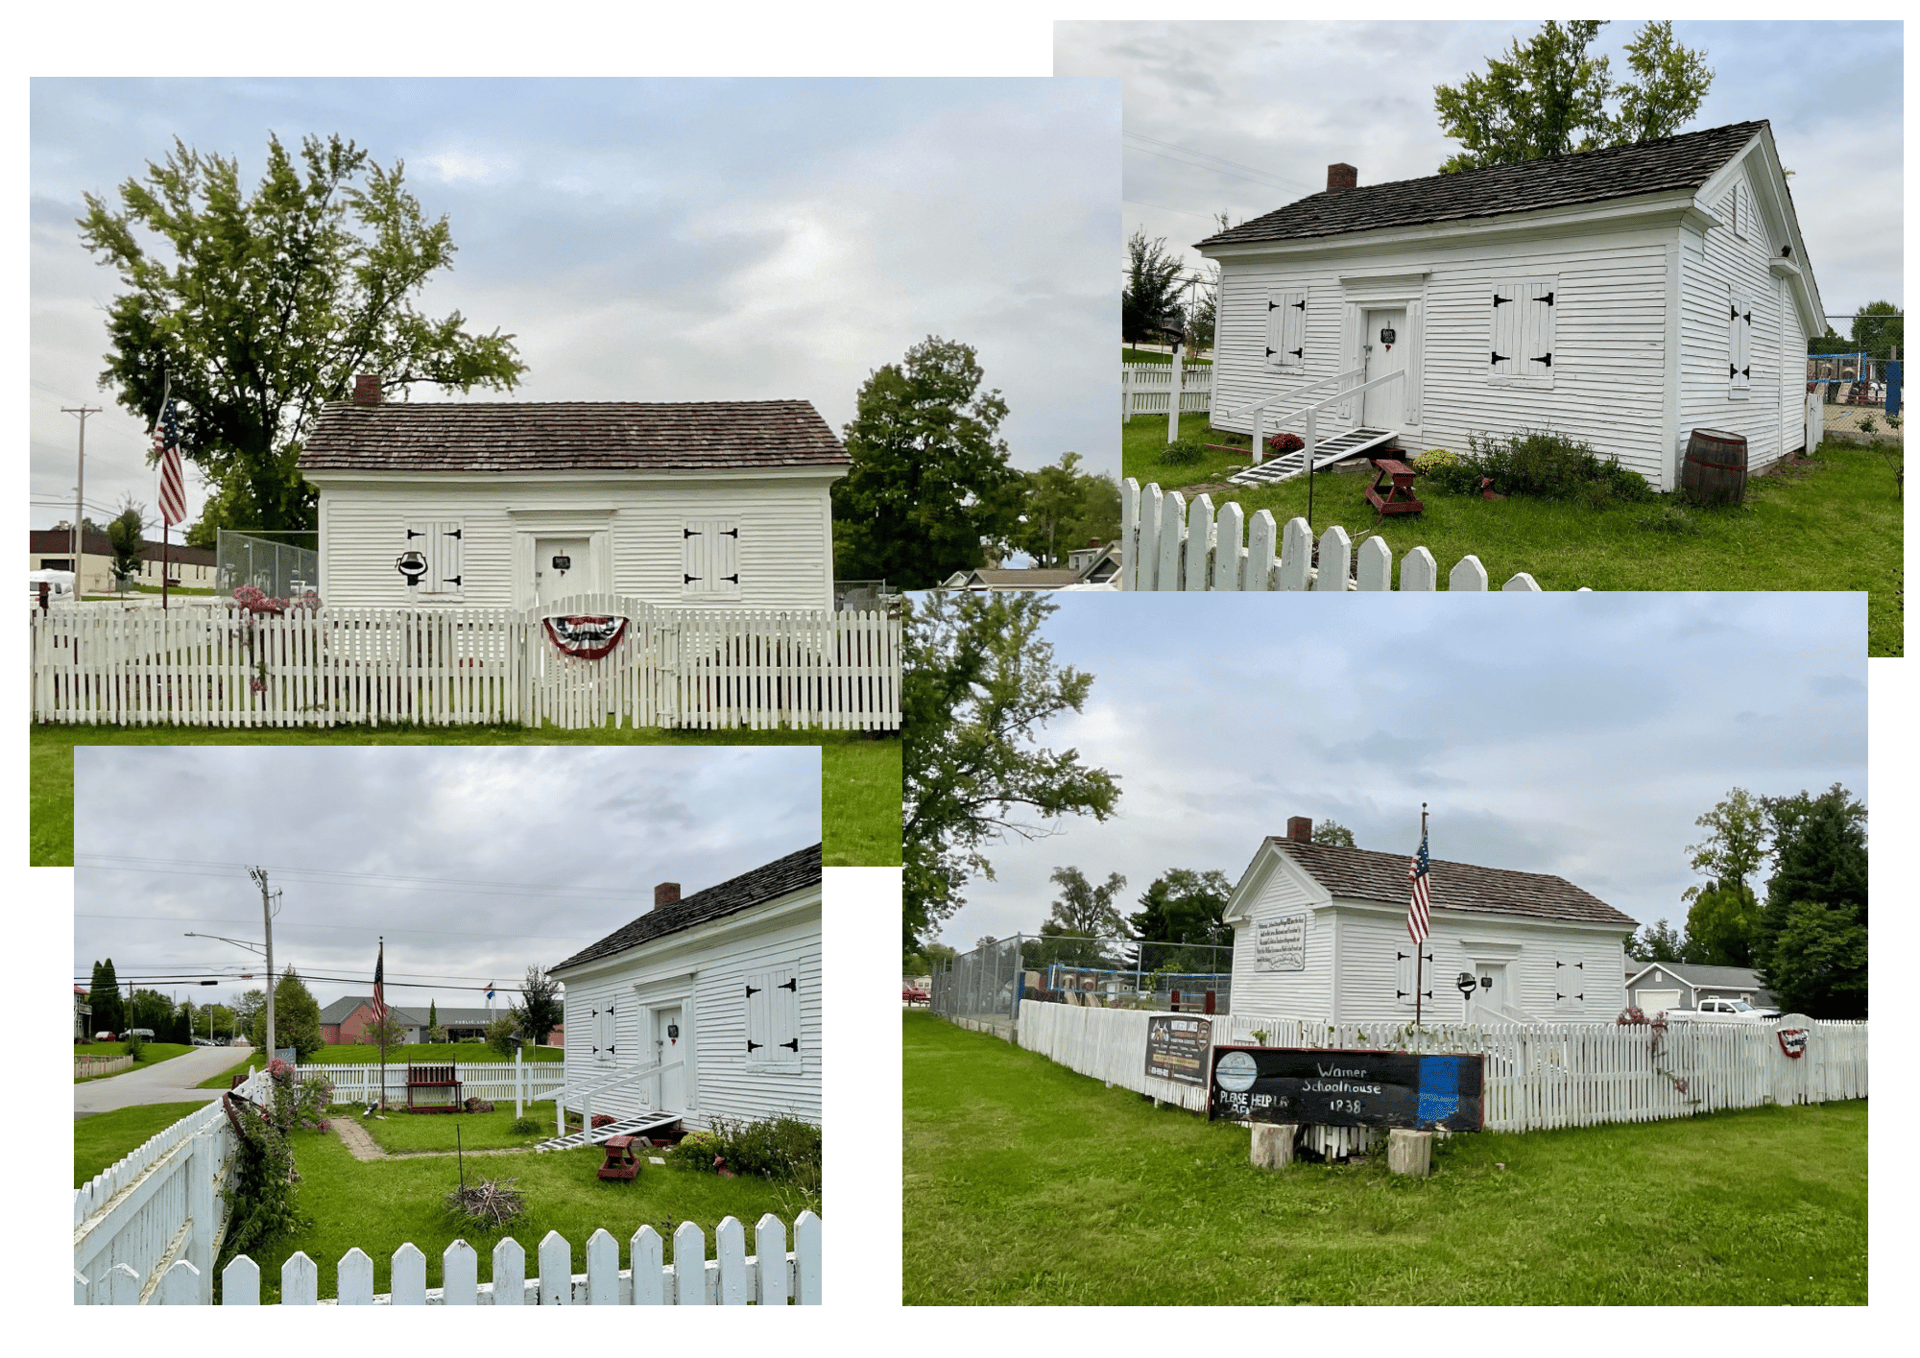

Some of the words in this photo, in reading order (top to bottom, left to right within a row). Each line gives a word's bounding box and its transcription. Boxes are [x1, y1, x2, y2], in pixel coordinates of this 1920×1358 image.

[1302, 1080, 1382, 1094] Schoolhouse
[1220, 1090, 1248, 1105] PLEASE
[1251, 1093, 1272, 1108] HELP
